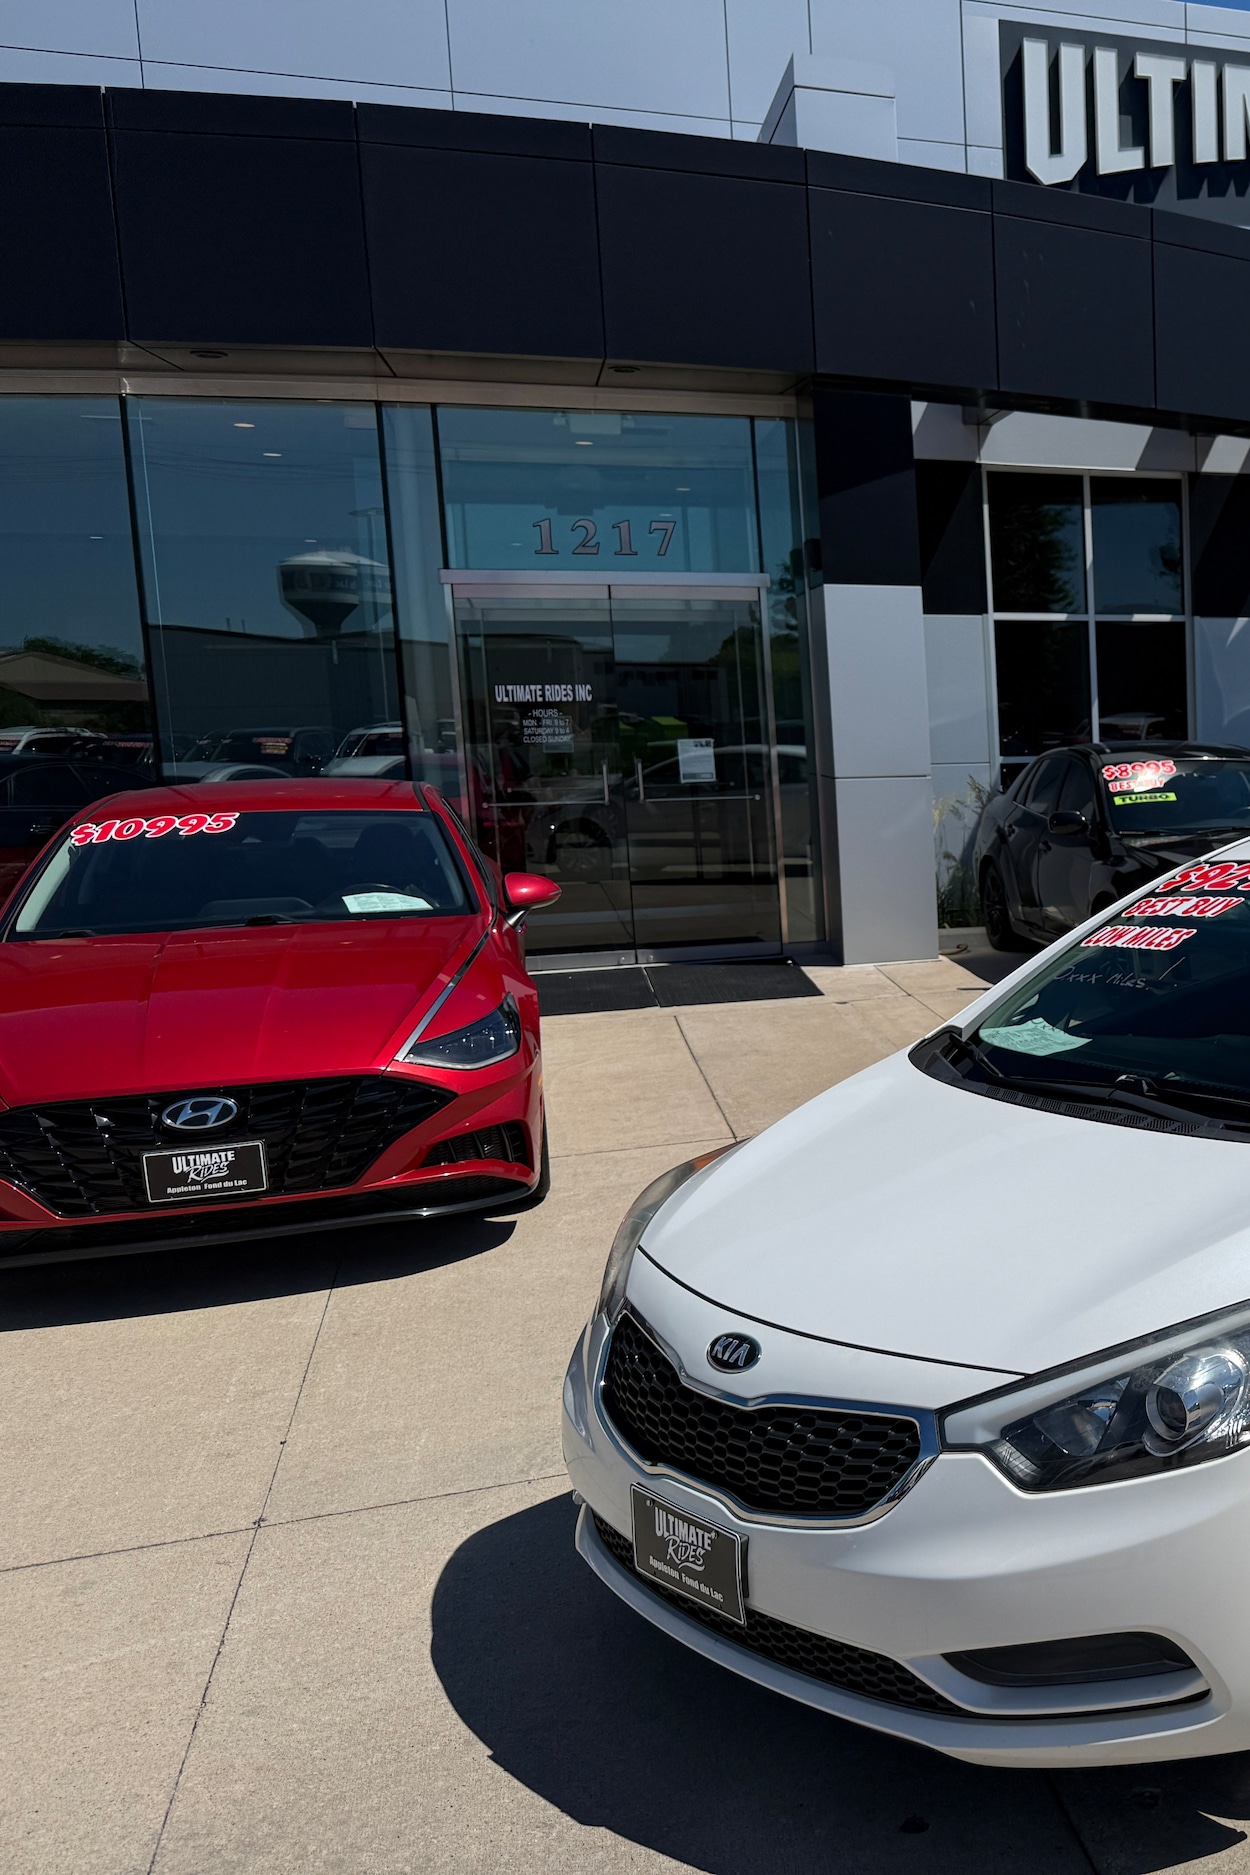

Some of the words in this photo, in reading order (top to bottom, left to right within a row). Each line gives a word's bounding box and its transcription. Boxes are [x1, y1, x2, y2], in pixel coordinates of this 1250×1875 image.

[533, 518, 676, 556] 1217
[495, 685, 543, 702] ULTIMATE
[545, 684, 573, 702] RIDES
[575, 684, 592, 701] INC
[532, 708, 558, 717] HOURS
[524, 727, 554, 735] SATURDAY
[548, 735, 571, 743] SUNDAY
[1102, 760, 1177, 780] $8995
[1119, 793, 1169, 803] TURBO
[70, 812, 240, 846] $10995
[1121, 897, 1190, 917] BEST
[1181, 897, 1245, 917] BUY
[1081, 926, 1131, 947] LOW
[1121, 926, 1198, 950] MILES
[171, 1150, 236, 1175] ULTIMATE
[166, 1184, 201, 1194] Appleton
[204, 1181, 223, 1190] Fond
[223, 1180, 233, 1188] du
[234, 1179, 248, 1187] Lac
[711, 1336, 751, 1367] KIA
[654, 1507, 712, 1551] ULTIMATE
[649, 1555, 680, 1580] Appleton
[681, 1573, 699, 1590] Fond
[700, 1584, 710, 1596] du
[710, 1587, 724, 1602] Lac
